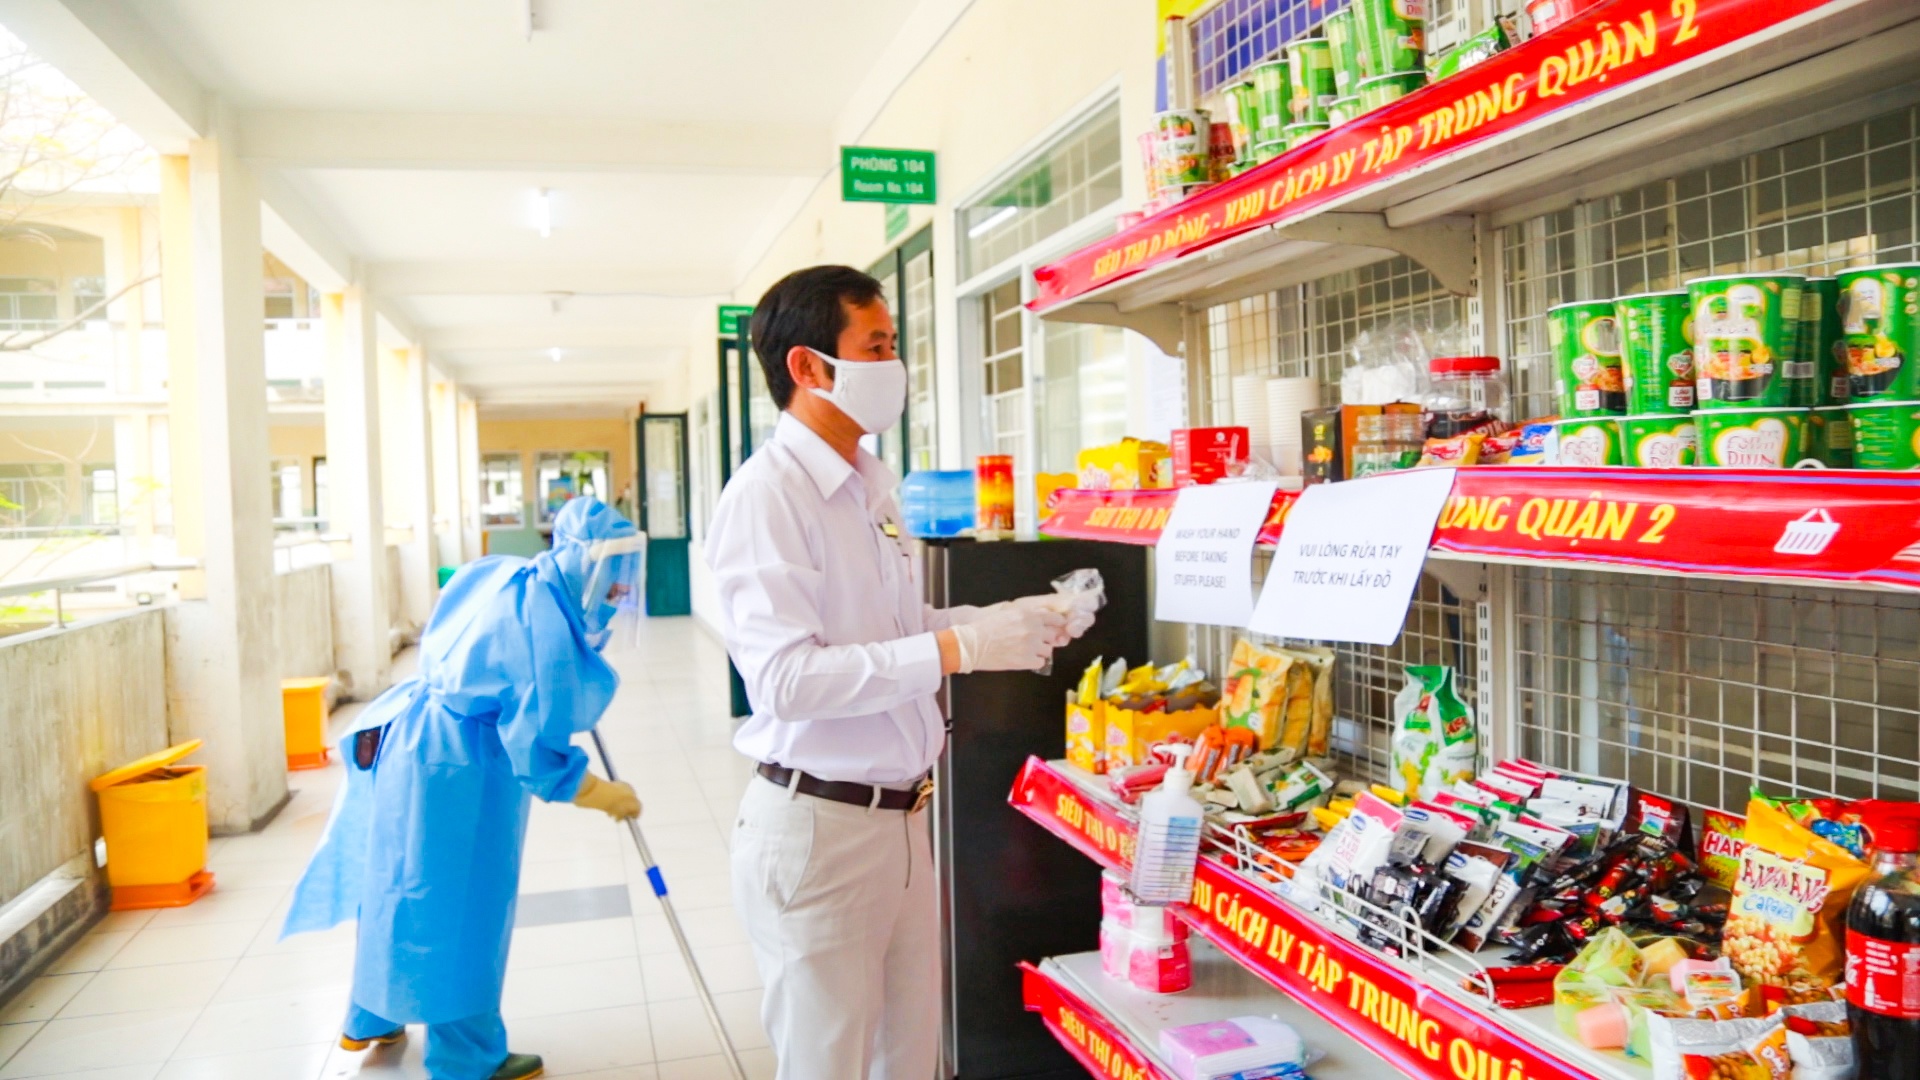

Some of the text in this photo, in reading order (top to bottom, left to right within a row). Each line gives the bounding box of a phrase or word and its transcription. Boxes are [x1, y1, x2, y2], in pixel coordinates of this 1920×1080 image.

[1223, 189, 1266, 229] KHU
[1268, 161, 1328, 211] CÁCH
[1329, 148, 1357, 187] LY
[1361, 126, 1413, 174] TẬP
[1418, 72, 1526, 151] TRUNG
[1537, 9, 1656, 98] QUẬN
[1671, 0, 1700, 45] 2
[1517, 491, 1639, 547] QUẬN
[1638, 504, 1676, 543] 2
[1217, 528, 1241, 539] HAND
[1175, 551, 1227, 563] BEFORE TAKING
[1299, 540, 1403, 559] VUI LÒNG RỬA TAY
[1174, 574, 1198, 586] STUFFS
[1293, 567, 1392, 588] TRƯỚC KHI LẤY ĐỒ
[1056, 794, 1083, 830] SIÊU
[1084, 811, 1105, 850] THỊ
[1215, 892, 1269, 948] CÁCH
[1267, 924, 1296, 964] LY
[1298, 940, 1343, 993] TẬP
[1348, 971, 1441, 1060] TRUNG
[1059, 1006, 1086, 1047] SIÊU
[1088, 1030, 1111, 1075] THỊ
